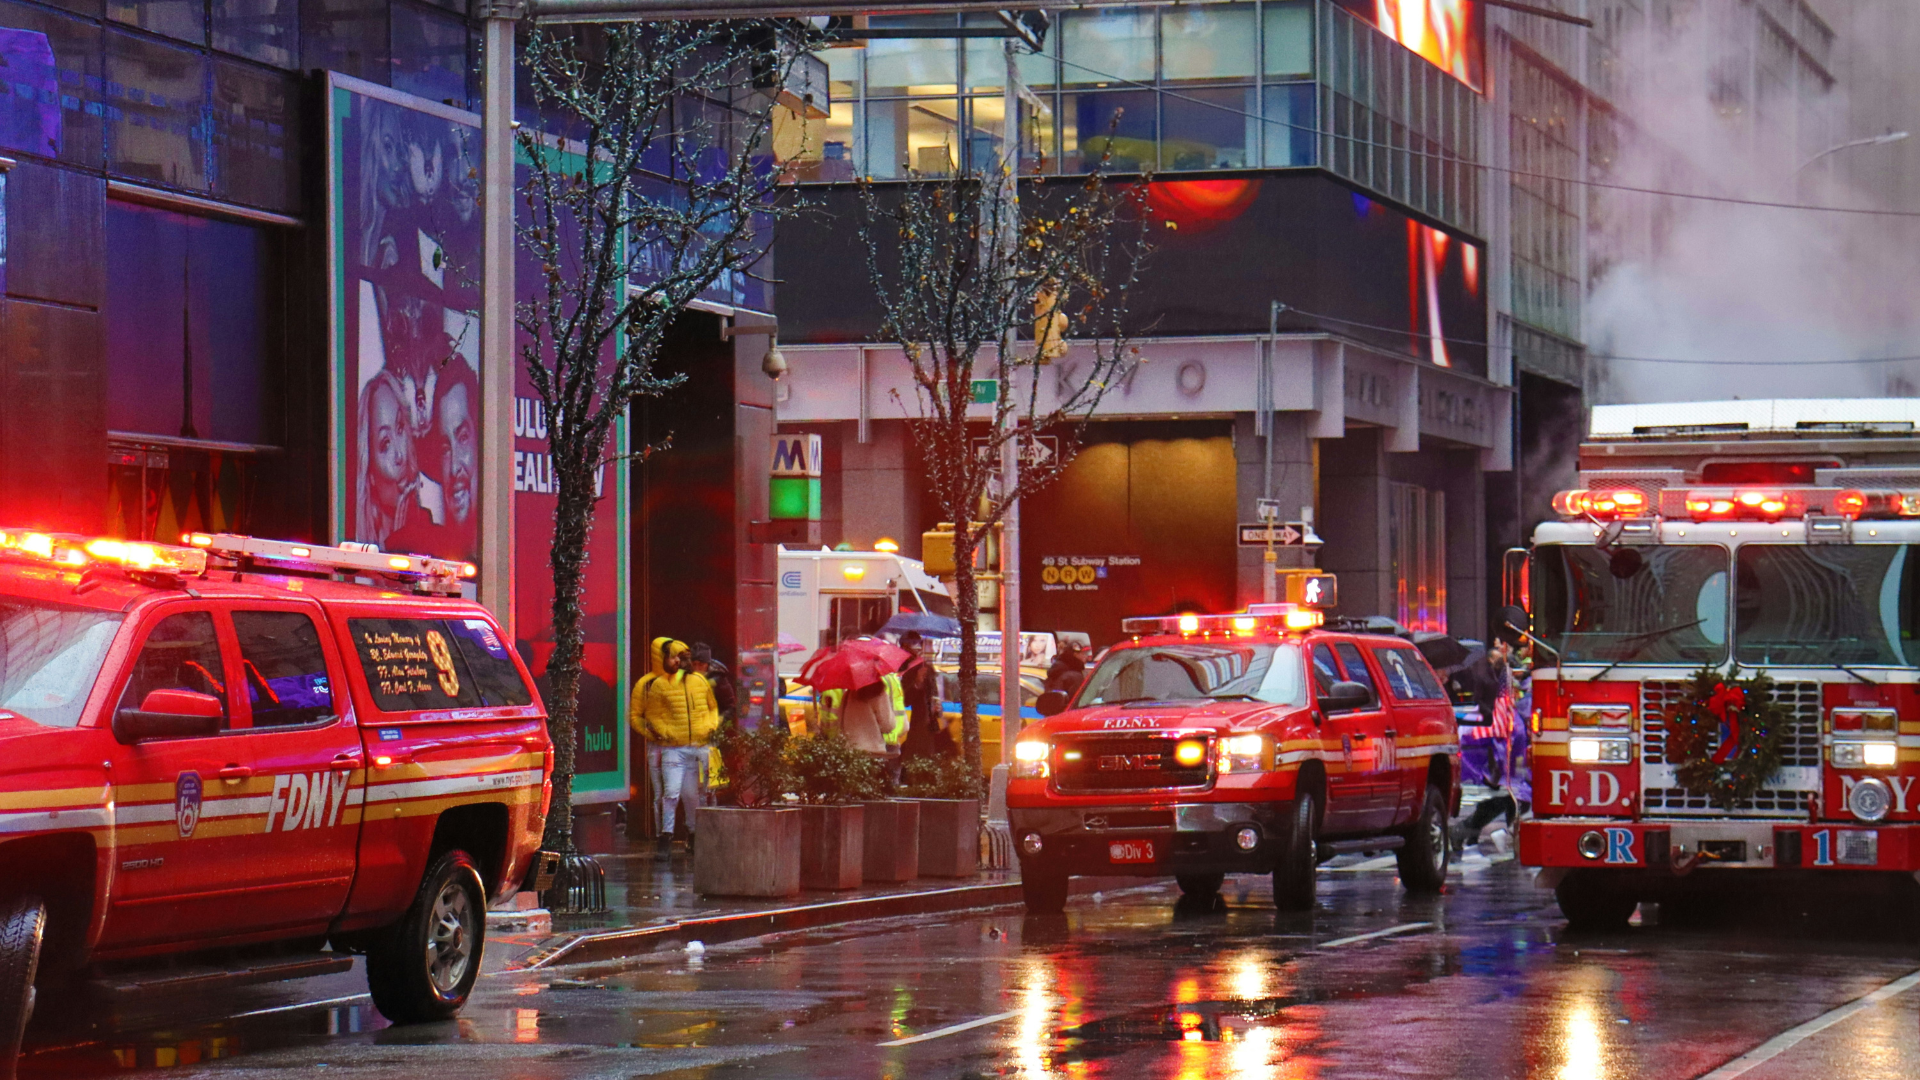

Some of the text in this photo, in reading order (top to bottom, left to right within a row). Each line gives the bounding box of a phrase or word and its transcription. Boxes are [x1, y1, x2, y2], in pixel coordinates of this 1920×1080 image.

[773, 440, 806, 470] M
[1248, 531, 1266, 539] ONE
[1042, 556, 1141, 567] 49 St Subway Station
[426, 630, 460, 697] 9
[1103, 718, 1161, 729] F.D.N.Y.
[584, 725, 612, 752] hulu
[1098, 754, 1161, 770] GMC
[1549, 769, 1631, 806] F.D.
[264, 771, 350, 833] FDNY
[1124, 843, 1154, 858] Div 3
[1604, 828, 1834, 866] R 1
